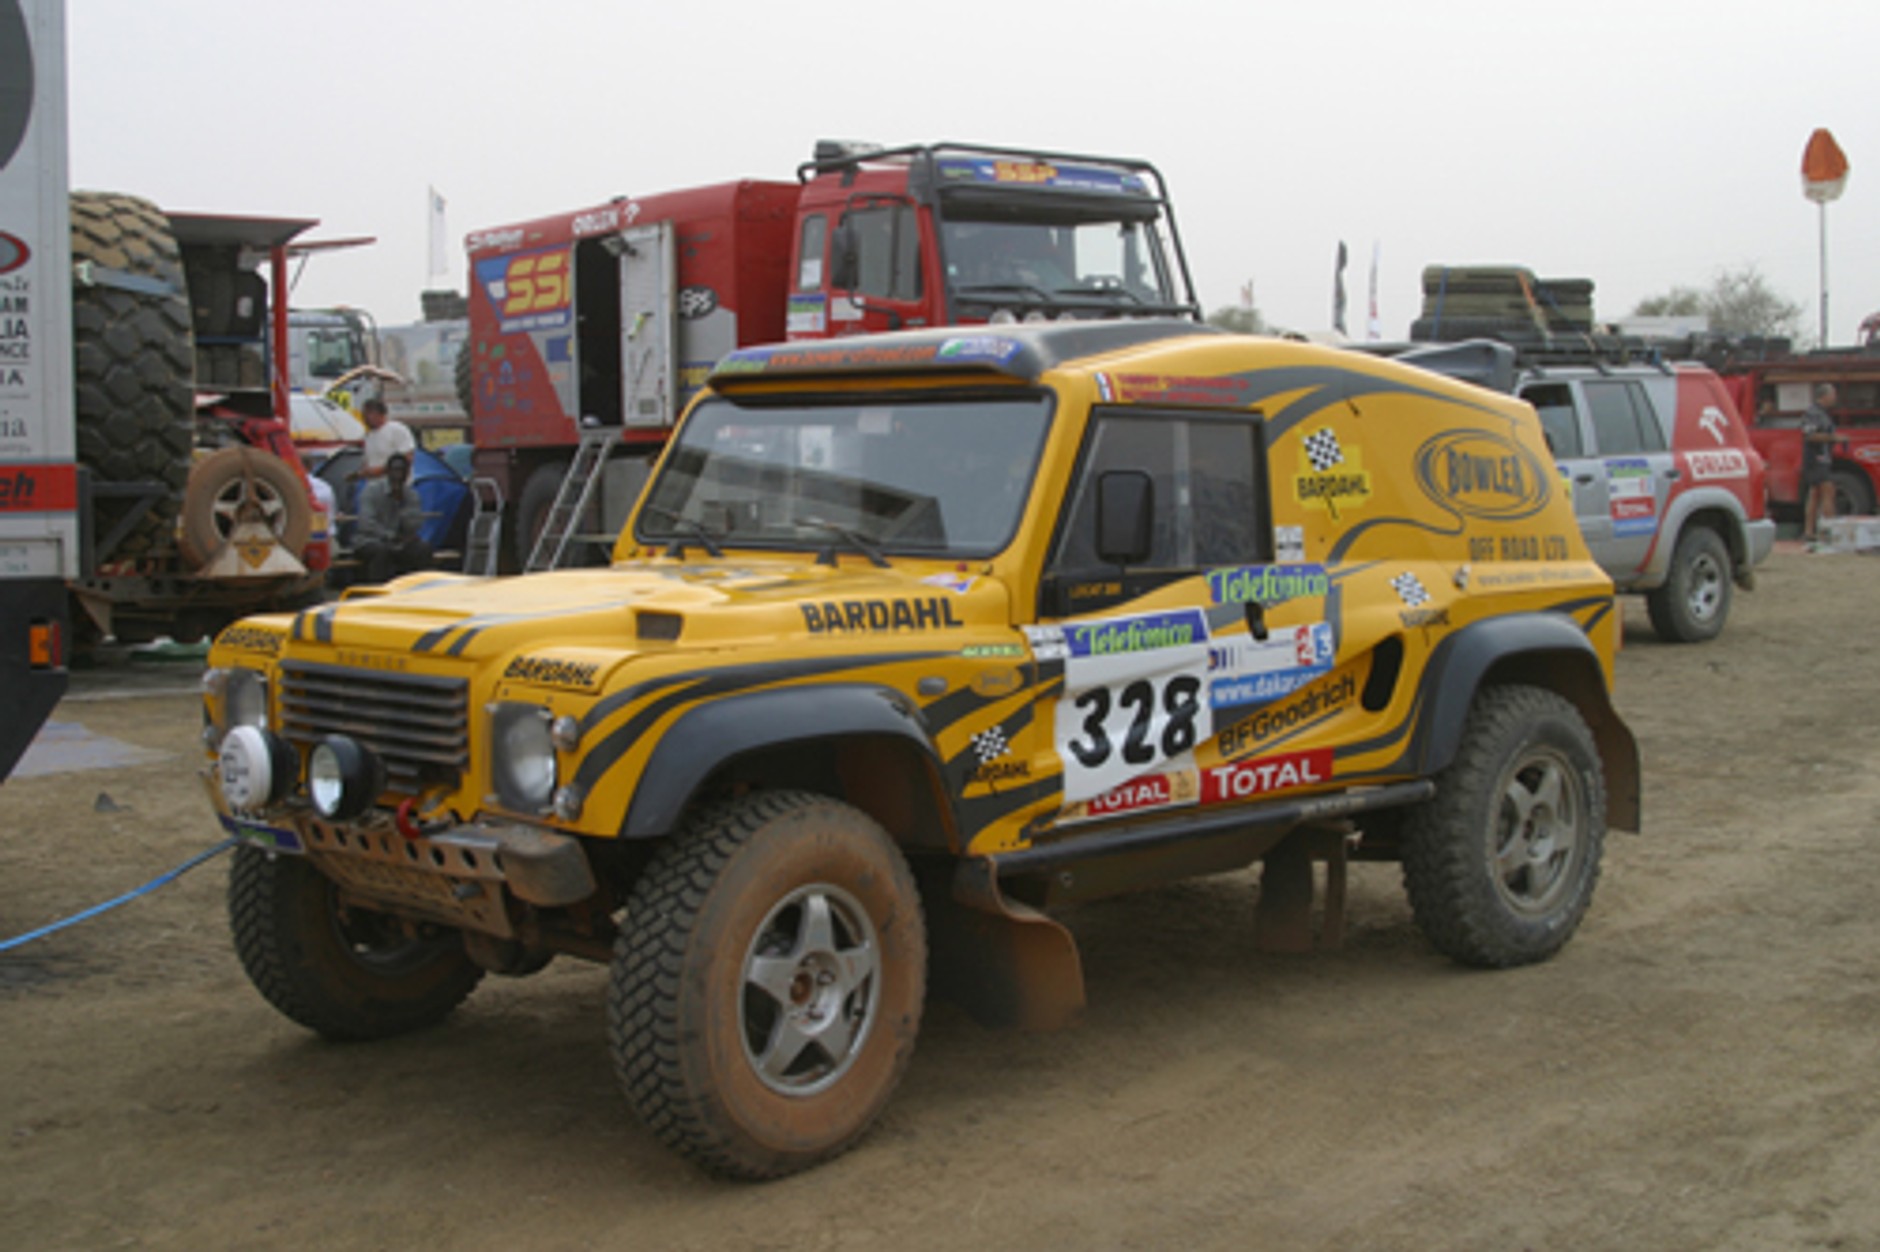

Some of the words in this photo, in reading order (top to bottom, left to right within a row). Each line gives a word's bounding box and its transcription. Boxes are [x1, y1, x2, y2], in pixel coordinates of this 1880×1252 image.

[504, 252, 571, 314] SS
[1298, 474, 1370, 501] BARDAHL
[1447, 446, 1525, 498] BOWLER
[1469, 536, 1495, 562] OFF
[1502, 535, 1540, 561] ROAD
[799, 597, 964, 634] BARDAHL
[503, 654, 600, 688] BARDAHL
[1068, 674, 1201, 769] 328
[1217, 669, 1356, 758] BFGoodrich
[1211, 759, 1321, 799] TOTAL
